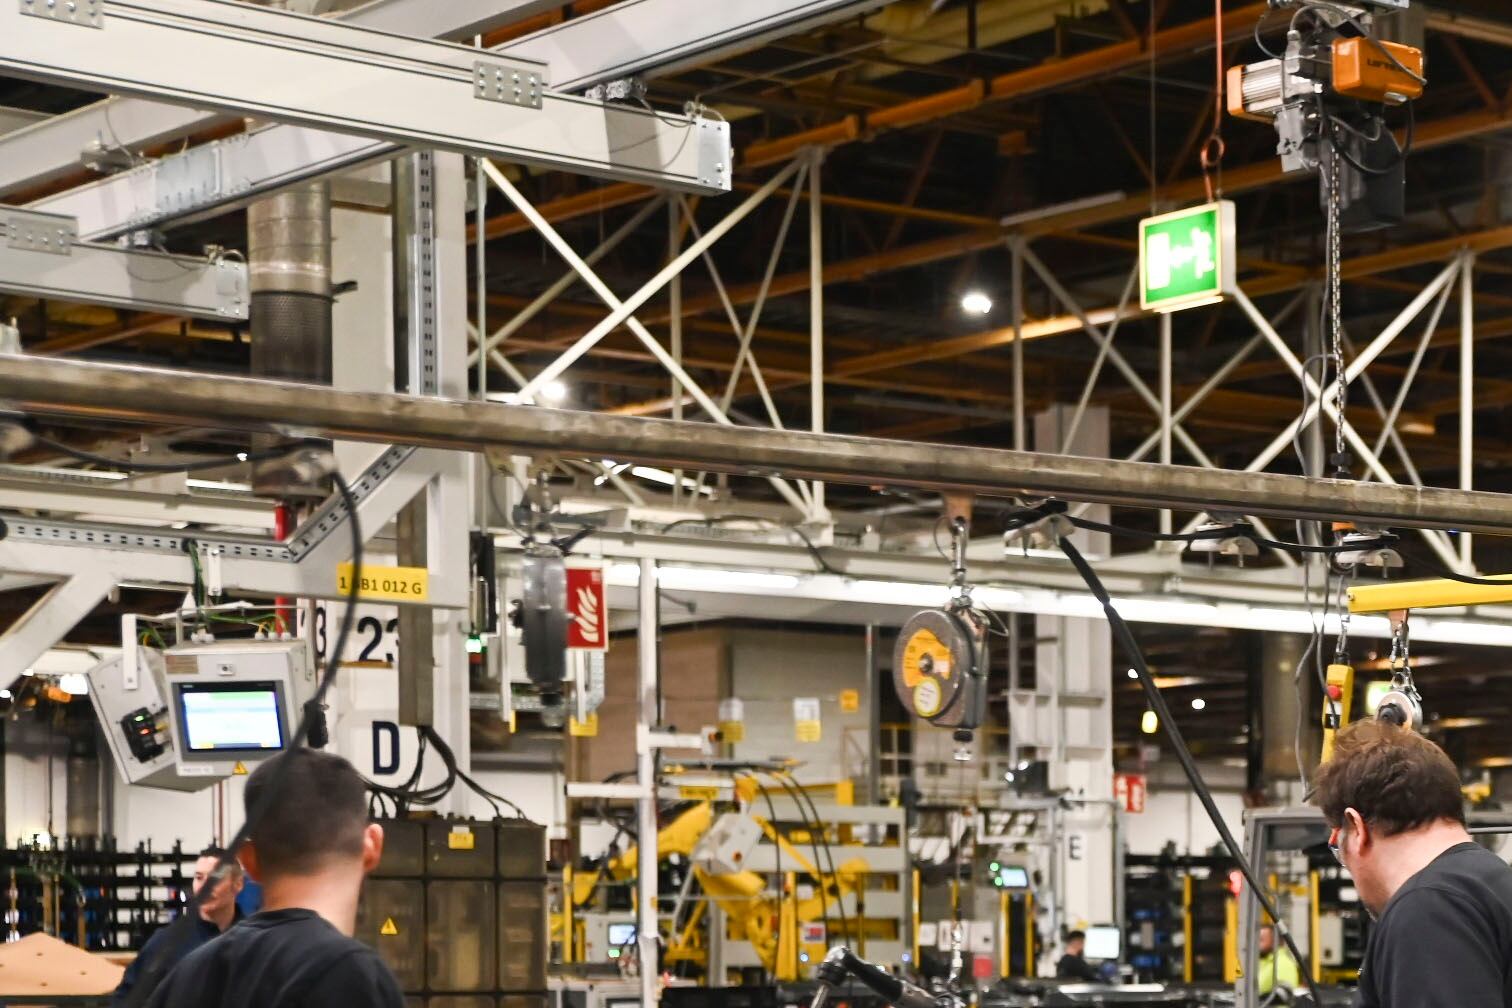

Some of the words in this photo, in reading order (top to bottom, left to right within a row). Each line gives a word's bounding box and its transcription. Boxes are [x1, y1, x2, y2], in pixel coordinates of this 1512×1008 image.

[383, 580, 408, 594] 012
[412, 582, 422, 595] G
[371, 720, 400, 775] D
